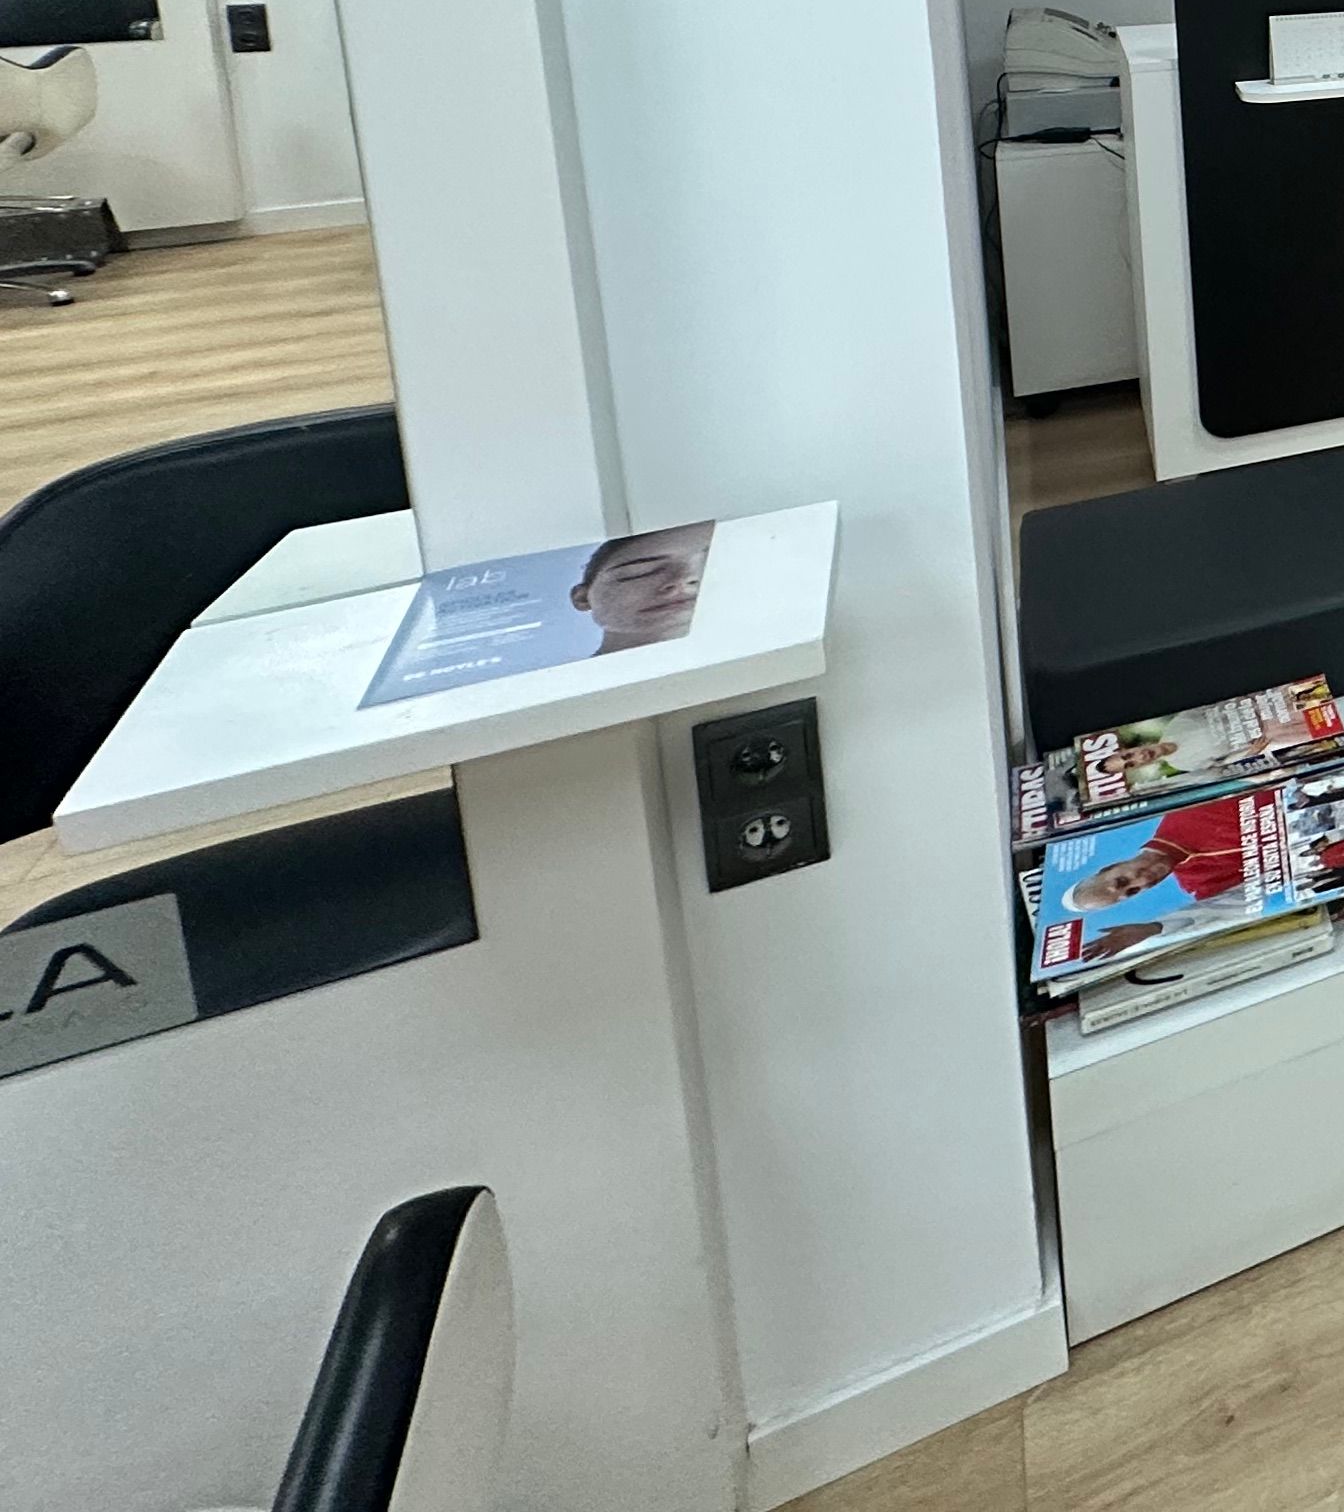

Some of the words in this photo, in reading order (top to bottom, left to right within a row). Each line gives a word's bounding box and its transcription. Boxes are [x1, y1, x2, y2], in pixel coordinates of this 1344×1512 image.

[446, 569, 507, 591] lab
[1238, 795, 1256, 834] HISTORIA
[1256, 802, 1278, 836] ESPAÑA
[1241, 831, 1257, 858] HACE
[1261, 832, 1277, 843] A
[1240, 855, 1259, 881] LEÓN
[1262, 840, 1280, 870] VISITA
[1265, 867, 1281, 883] SU
[1268, 879, 1283, 894] EN
[1044, 922, 1072, 965] ¡HOLA!
[0, 943, 138, 1021] A
